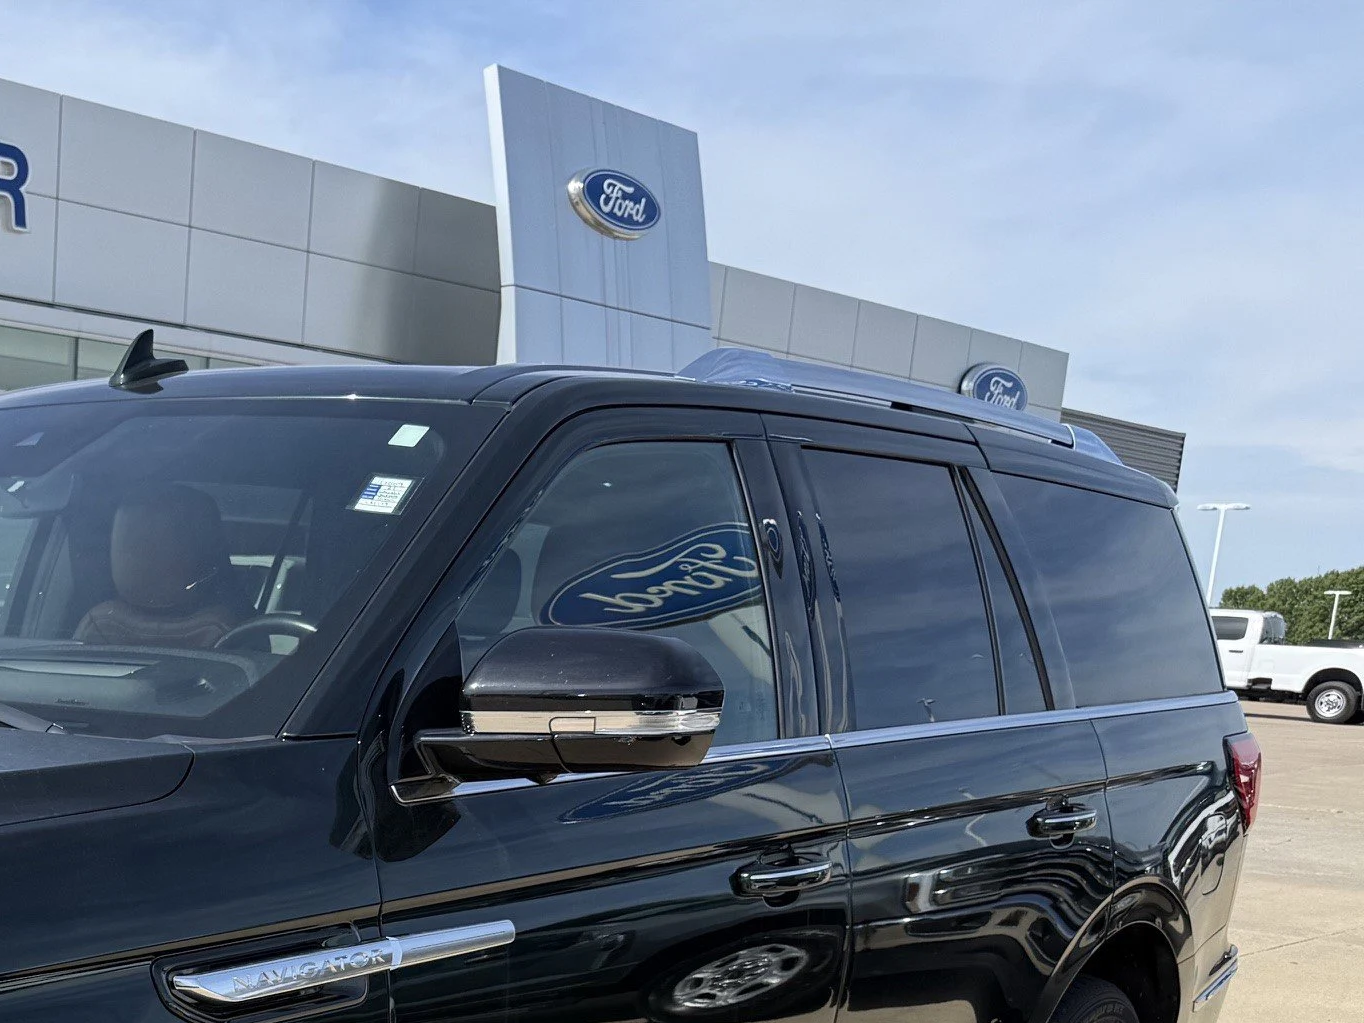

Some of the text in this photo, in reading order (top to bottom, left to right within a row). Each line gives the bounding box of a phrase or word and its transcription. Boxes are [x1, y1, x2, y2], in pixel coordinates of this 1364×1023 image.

[600, 178, 646, 223] Ford
[984, 376, 1020, 409] Ford
[233, 949, 386, 992] NAVIGATOR
